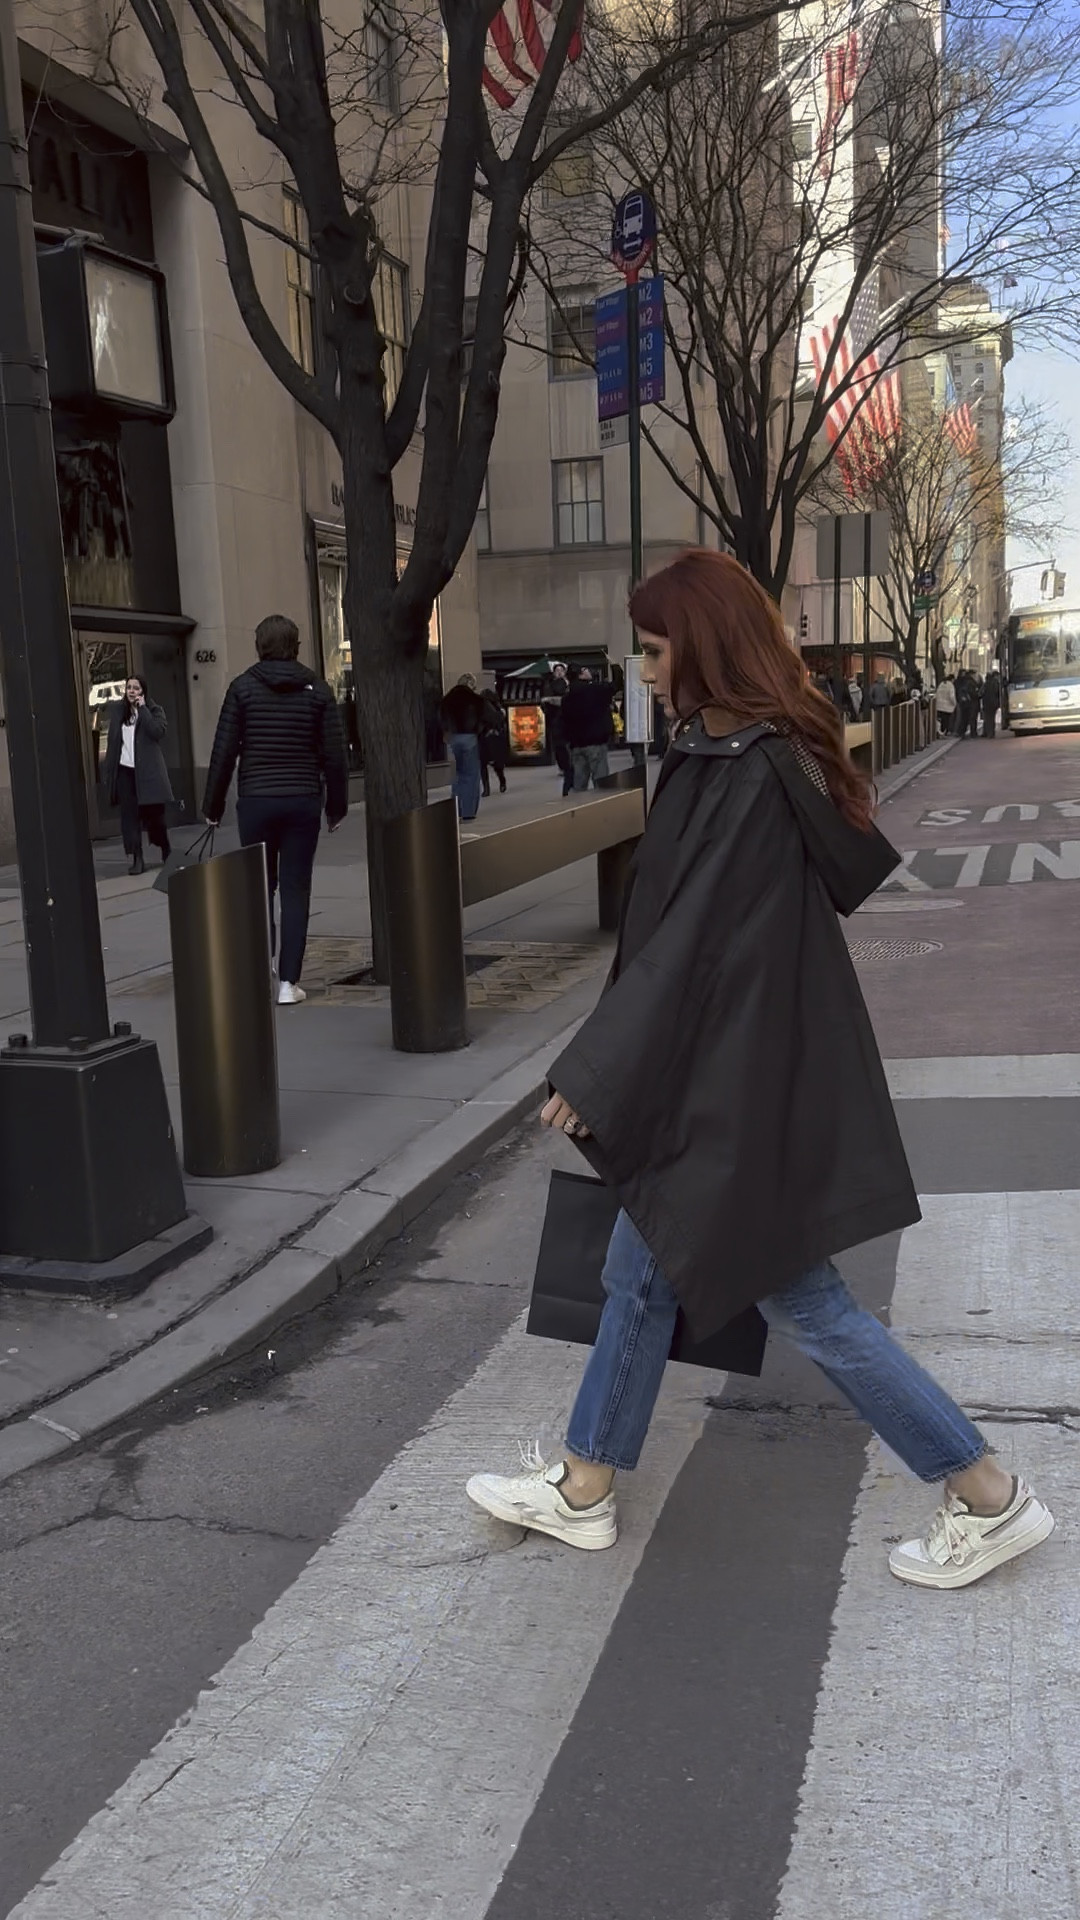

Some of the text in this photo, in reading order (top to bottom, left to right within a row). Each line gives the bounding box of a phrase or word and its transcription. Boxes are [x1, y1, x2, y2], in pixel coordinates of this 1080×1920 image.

[638, 282, 652, 303] M2
[639, 307, 653, 328] M2
[639, 332, 653, 352] M3
[639, 357, 653, 378] M5
[639, 382, 653, 401] M5
[196, 650, 217, 663] 626
